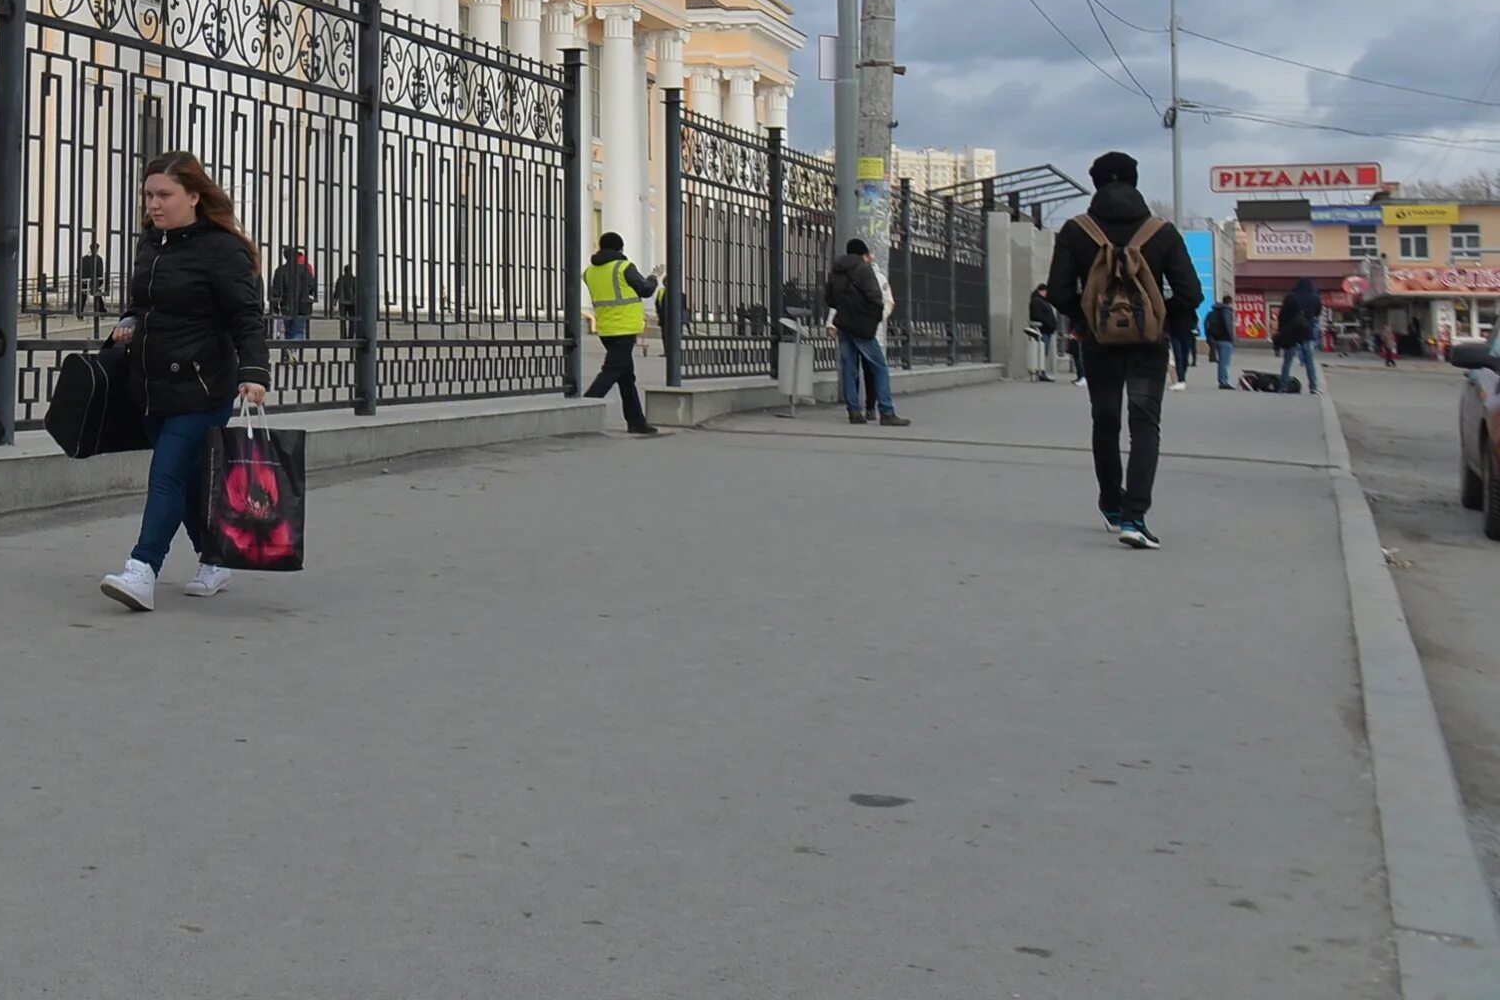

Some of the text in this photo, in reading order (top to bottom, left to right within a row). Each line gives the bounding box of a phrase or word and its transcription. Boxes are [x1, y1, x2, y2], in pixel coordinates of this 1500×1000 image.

[1219, 167, 1352, 187] PIZZA MIA
[1259, 232, 1313, 244] ХОСТЕЛ
